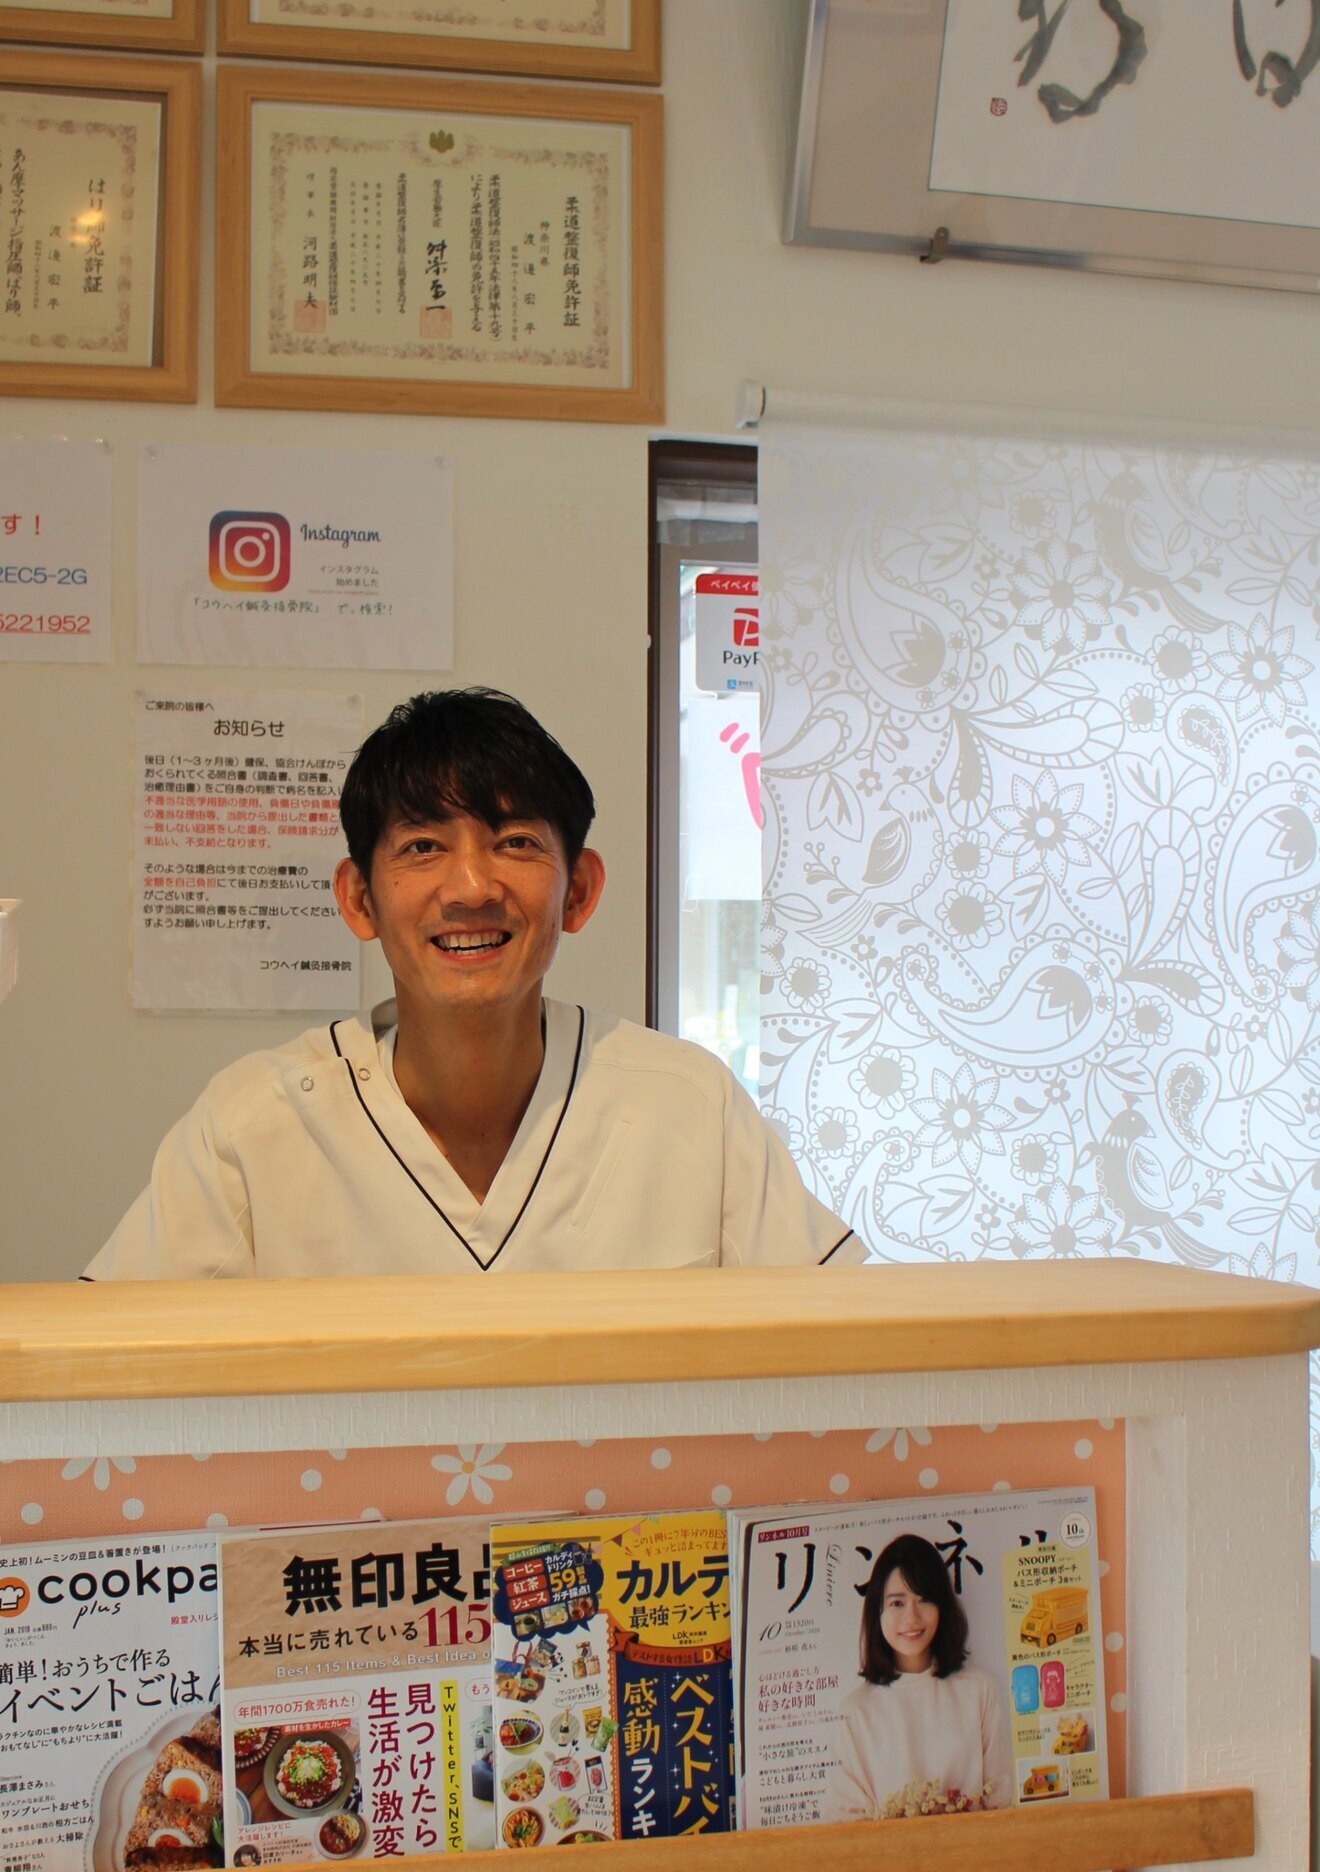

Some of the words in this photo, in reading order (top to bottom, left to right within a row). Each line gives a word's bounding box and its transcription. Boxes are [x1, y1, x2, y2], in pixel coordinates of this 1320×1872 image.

[562, 196, 581, 327] 柔道整復師免許証
[300, 524, 381, 548] Instagram
[319, 565, 380, 575] インスタグラム
[336, 577, 379, 588] 始めました
[145, 700, 215, 712] ご来院の皆様へ
[213, 718, 285, 738] お知らせ
[144, 863, 308, 876] そのような場合は今までの治療費の
[144, 891, 210, 902] がございます。
[144, 918, 271, 931] すようお願い申し上げます。
[259, 960, 352, 972] コウヘイ鍼灸接骨院
[759, 1527, 809, 1542] リンネル10月号
[545, 1551, 573, 1564] カルディ
[547, 1560, 573, 1573] ドリンク
[775, 1520, 1047, 1613] リンネ
[1018, 1553, 1057, 1566] SNOOPY
[505, 1563, 542, 1578] コーヒー
[1017, 1564, 1078, 1577] バス形収納ポーチ
[513, 1576, 539, 1594] 紅茶
[549, 1568, 576, 1592] 59
[512, 1591, 547, 1610] ジュース
[73, 1601, 121, 1629] plus
[759, 1621, 782, 1641] 10
[0, 1649, 170, 1685] 簡単！おうちで作る
[276, 1665, 310, 1679] Best
[316, 1661, 341, 1674] 115
[346, 1656, 386, 1671] Items
[391, 1654, 401, 1667] &
[407, 1650, 440, 1666] Best
[445, 1650, 477, 1662] Idea
[471, 1684, 490, 1696] もう
[758, 1675, 839, 1697] 私の好きな部屋
[1066, 1683, 1094, 1691] キャラクター
[758, 1694, 816, 1713] 好きな時間
[367, 1686, 405, 1858] 生活が激変
[405, 1683, 437, 1847] 見つけたら
[760, 1769, 826, 1787] こどもと暮らし大賞
[2, 1799, 90, 1819] ワンプレートおせち
[760, 1811, 821, 1827] 毎日ごちそうご飯
